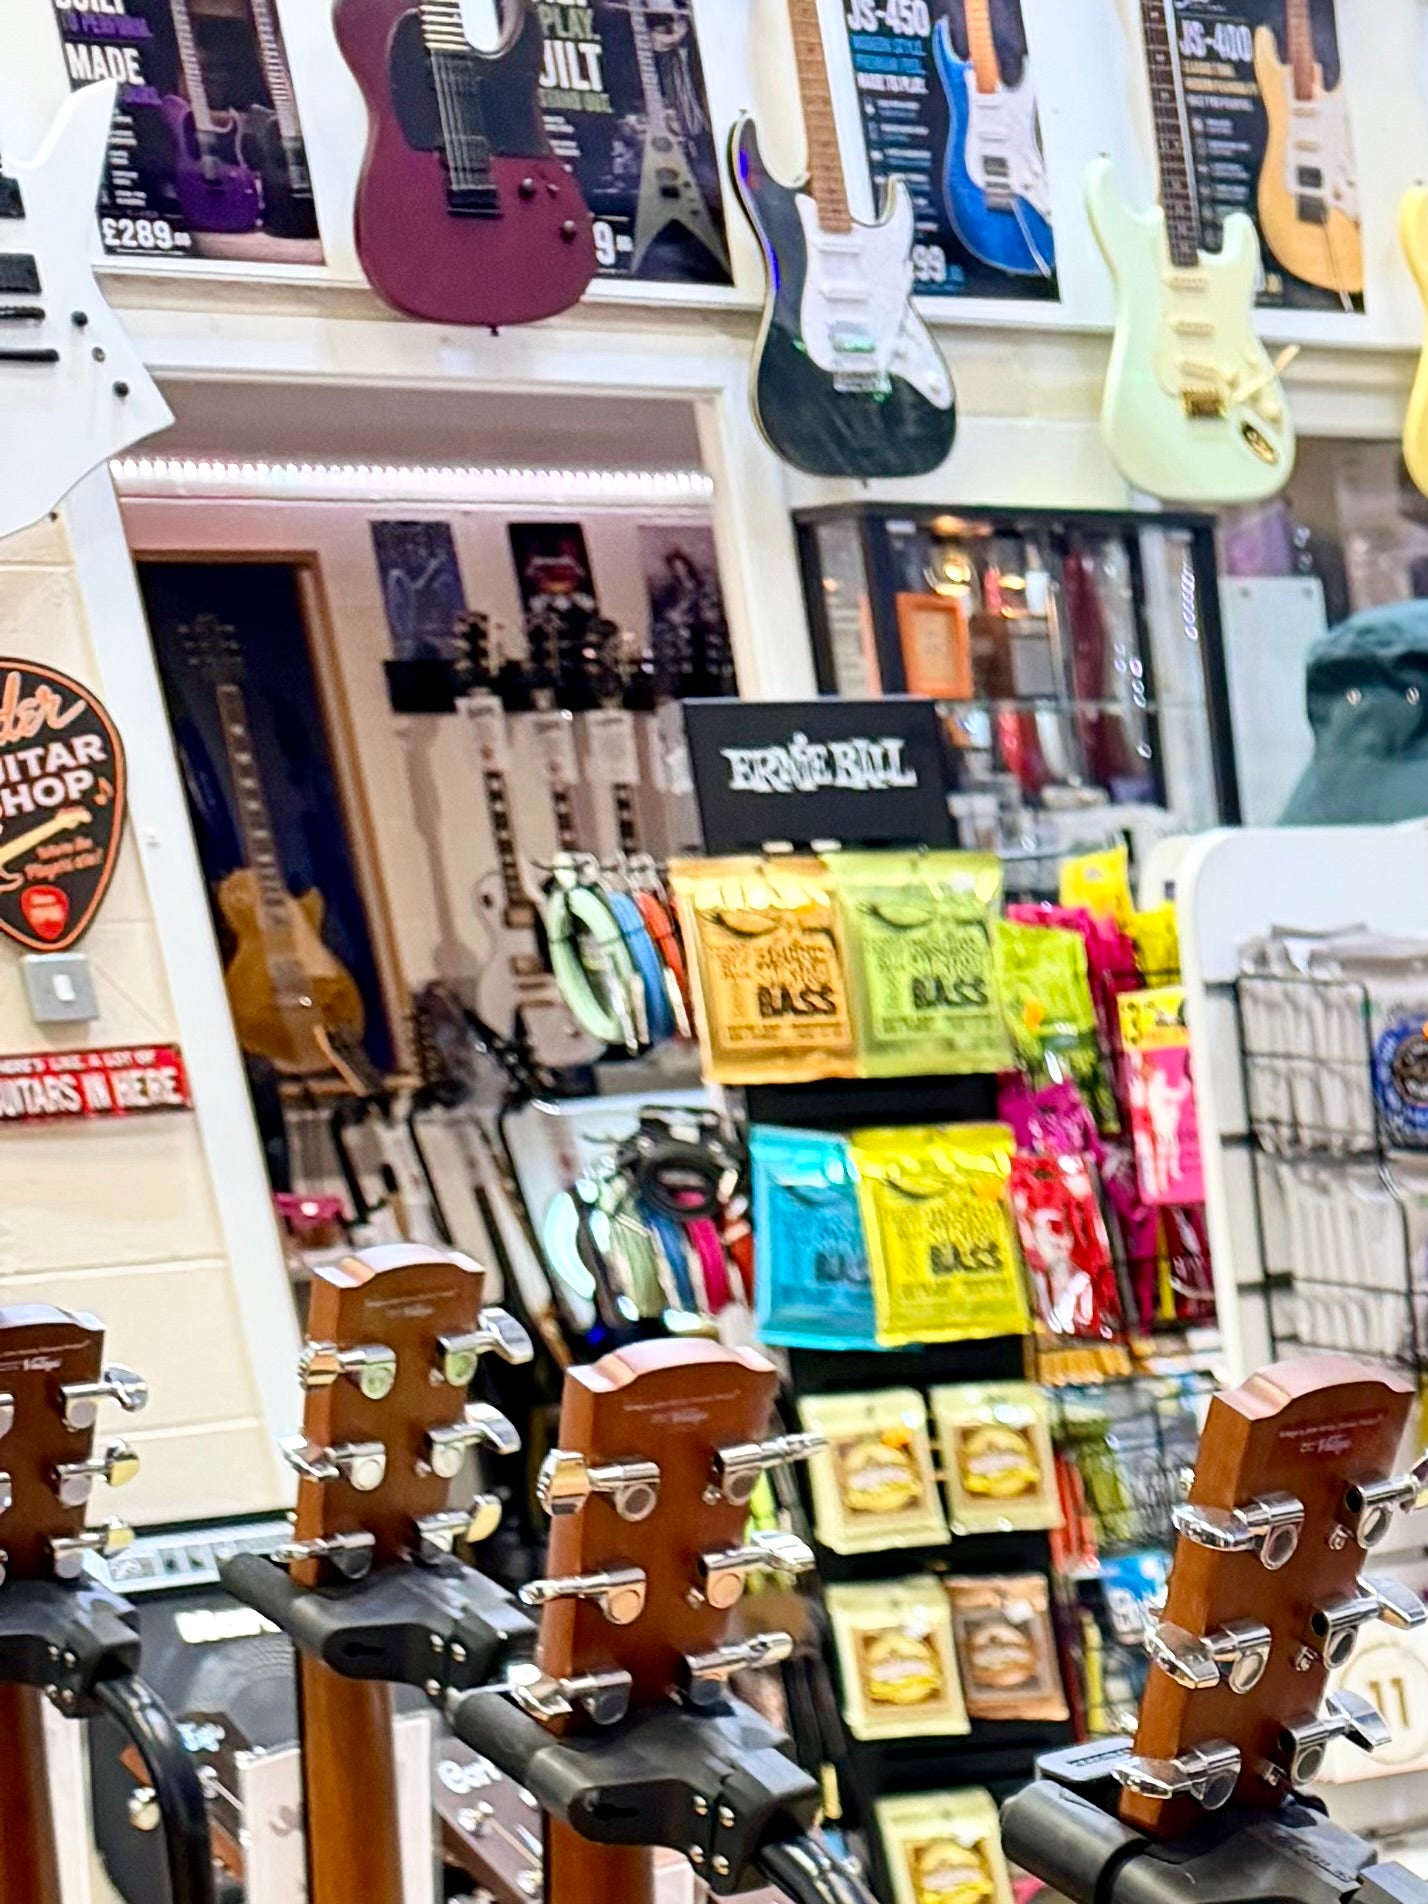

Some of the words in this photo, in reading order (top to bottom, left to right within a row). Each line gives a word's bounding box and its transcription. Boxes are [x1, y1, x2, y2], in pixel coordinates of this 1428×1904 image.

[64, 42, 146, 86] MADE
[0, 671, 85, 746] der
[0, 734, 107, 786] ITAR
[720, 731, 833, 793] ERNIE
[829, 737, 918, 790] BALL
[0, 769, 96, 820] HOP
[757, 983, 837, 1018] BASS
[912, 975, 988, 1010] BASS
[115, 1065, 184, 1111] HERE
[1369, 1677, 1411, 1728] 11
